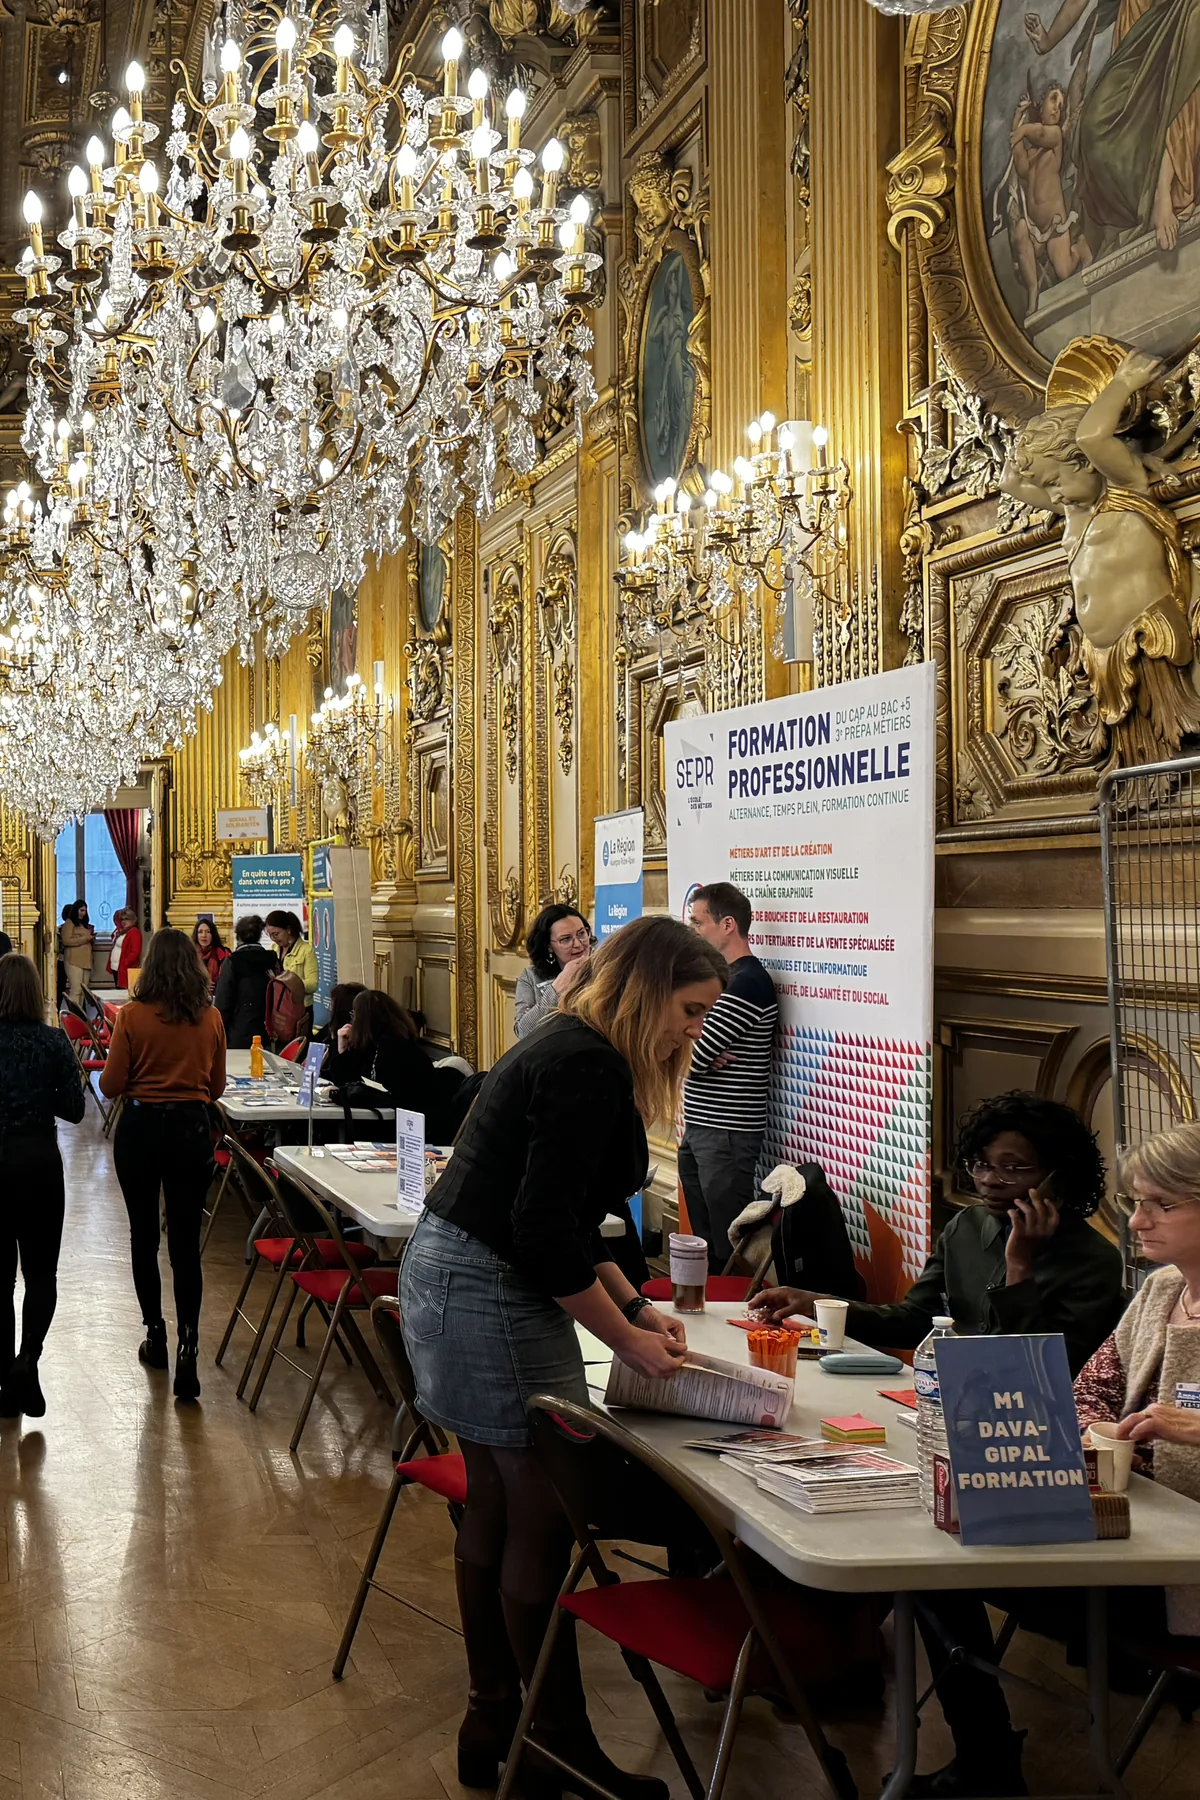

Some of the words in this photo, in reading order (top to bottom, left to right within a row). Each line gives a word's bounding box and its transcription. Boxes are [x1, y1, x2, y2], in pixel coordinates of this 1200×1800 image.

[836, 711, 847, 725] DU
[848, 706, 865, 722] CAP
[866, 704, 878, 719] AU
[880, 699, 898, 717] BAC
[900, 696, 911, 712] +5
[728, 712, 831, 760] FORMATION
[844, 721, 872, 740] PRÉPA
[873, 714, 911, 737] MÉTIERS
[676, 756, 714, 789] SEPR
[728, 742, 911, 799] PROFESSIONNELLE
[728, 804, 772, 820] ALTERNANCE,
[773, 802, 796, 818] TEMPS
[797, 800, 820, 816] PLEIN,
[822, 794, 866, 812] FORMATION
[867, 788, 910, 808] CONTINUE
[610, 840, 616, 854] La
[617, 838, 636, 856] Région
[730, 845, 754, 859] MÉTIERS
[755, 847, 772, 858] D'ART
[773, 846, 781, 857] ET
[782, 846, 789, 857] DE
[790, 845, 799, 856] LA
[800, 841, 833, 856] CRÉATION
[250, 869, 267, 878] quête
[730, 868, 754, 882] MÉTIERS
[755, 871, 763, 881] DE
[764, 870, 772, 881] LA
[773, 869, 825, 881] COMMUNICATION
[826, 867, 859, 880] VISUELLE
[747, 888, 754, 898] LA
[755, 884, 777, 898] CHAÎNE
[778, 887, 814, 898] GRAPHIQUE
[608, 905, 613, 917] La
[613, 904, 628, 919] Région
[756, 911, 764, 922] DE
[765, 911, 789, 922] BOUCHE
[790, 912, 797, 923] ET
[798, 912, 807, 923] DE
[808, 912, 816, 923] LA
[818, 912, 869, 924] RESTAURATION
[756, 935, 764, 946] DU
[765, 935, 796, 947] TERTIAIRE
[797, 937, 805, 948] ET
[806, 937, 815, 948] DE
[816, 938, 824, 949] LA
[825, 938, 848, 949] VENTE
[849, 934, 895, 951] SPÉCIALISÉE
[758, 958, 793, 971] ECHNIQUES
[794, 961, 802, 972] ET
[803, 962, 812, 973] DE
[812, 962, 868, 977] L'INFORMATIQUE
[800, 986, 808, 997] DE
[810, 987, 818, 998] LA
[819, 986, 841, 1001] SANTÉ
[843, 990, 851, 1002] ET
[852, 991, 862, 1003] DU
[863, 992, 889, 1006] SOCIAL
[993, 1391, 1025, 1410] M1
[978, 1420, 1048, 1438] DAVA-
[985, 1445, 1050, 1463] GIPAL
[958, 1469, 1084, 1490] FORMATION
